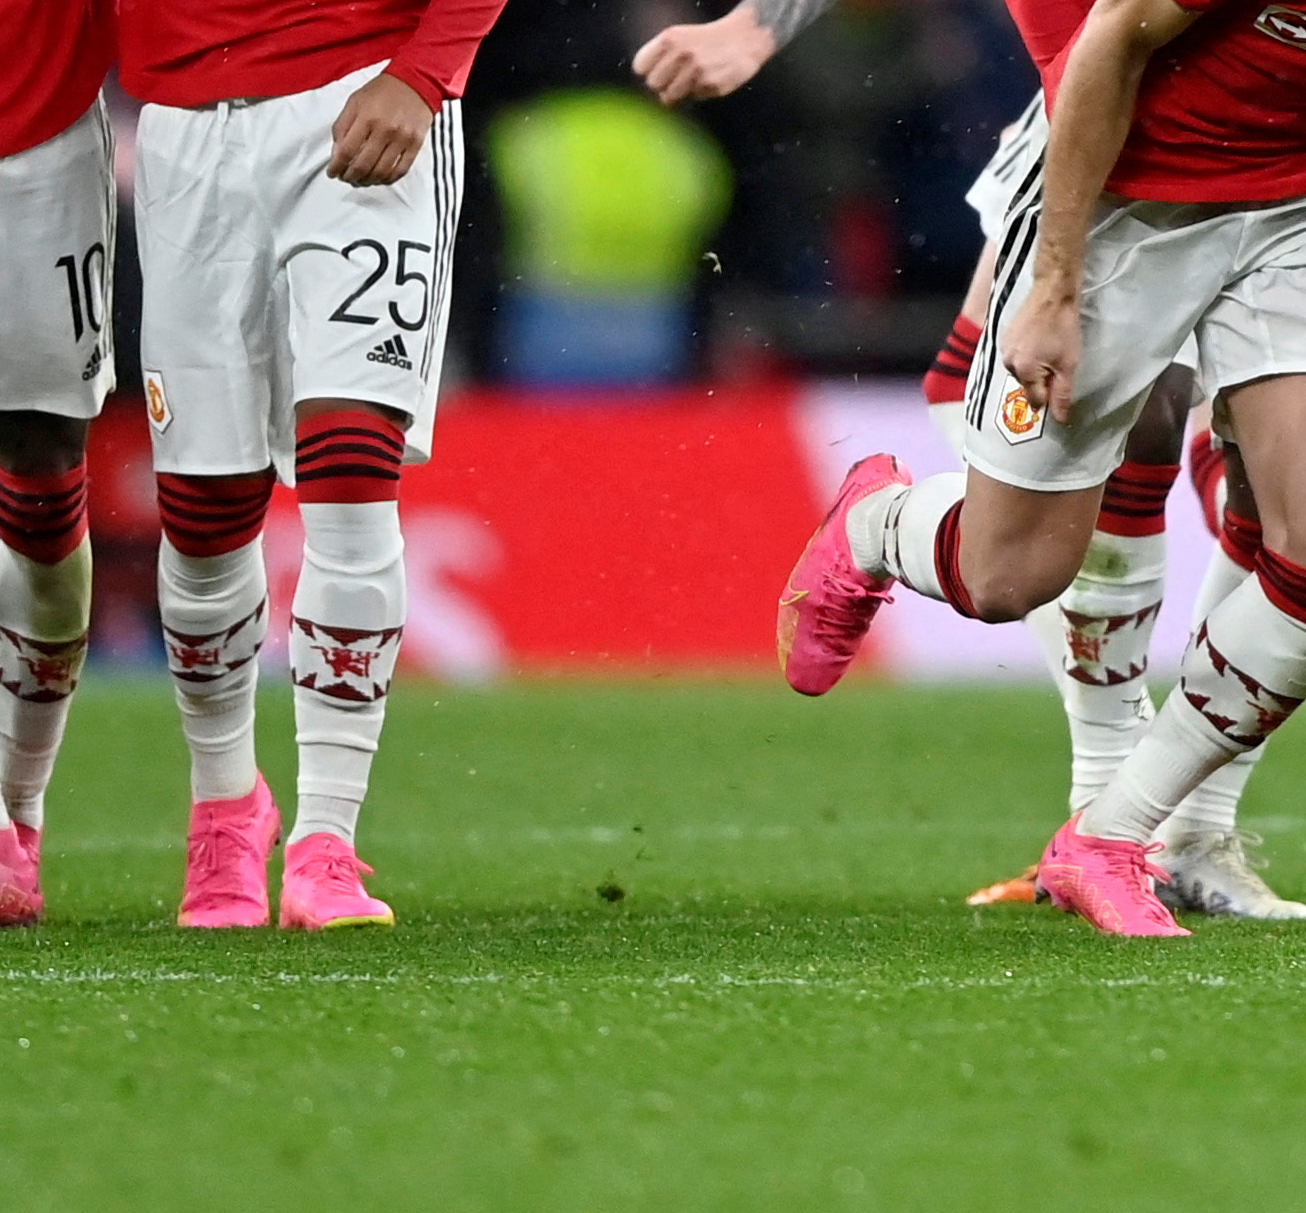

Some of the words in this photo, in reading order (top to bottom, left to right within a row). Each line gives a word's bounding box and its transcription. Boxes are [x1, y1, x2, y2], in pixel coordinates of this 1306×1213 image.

[55, 242, 105, 344] 10
[328, 238, 432, 332] 25
[366, 352, 413, 371] adidas
